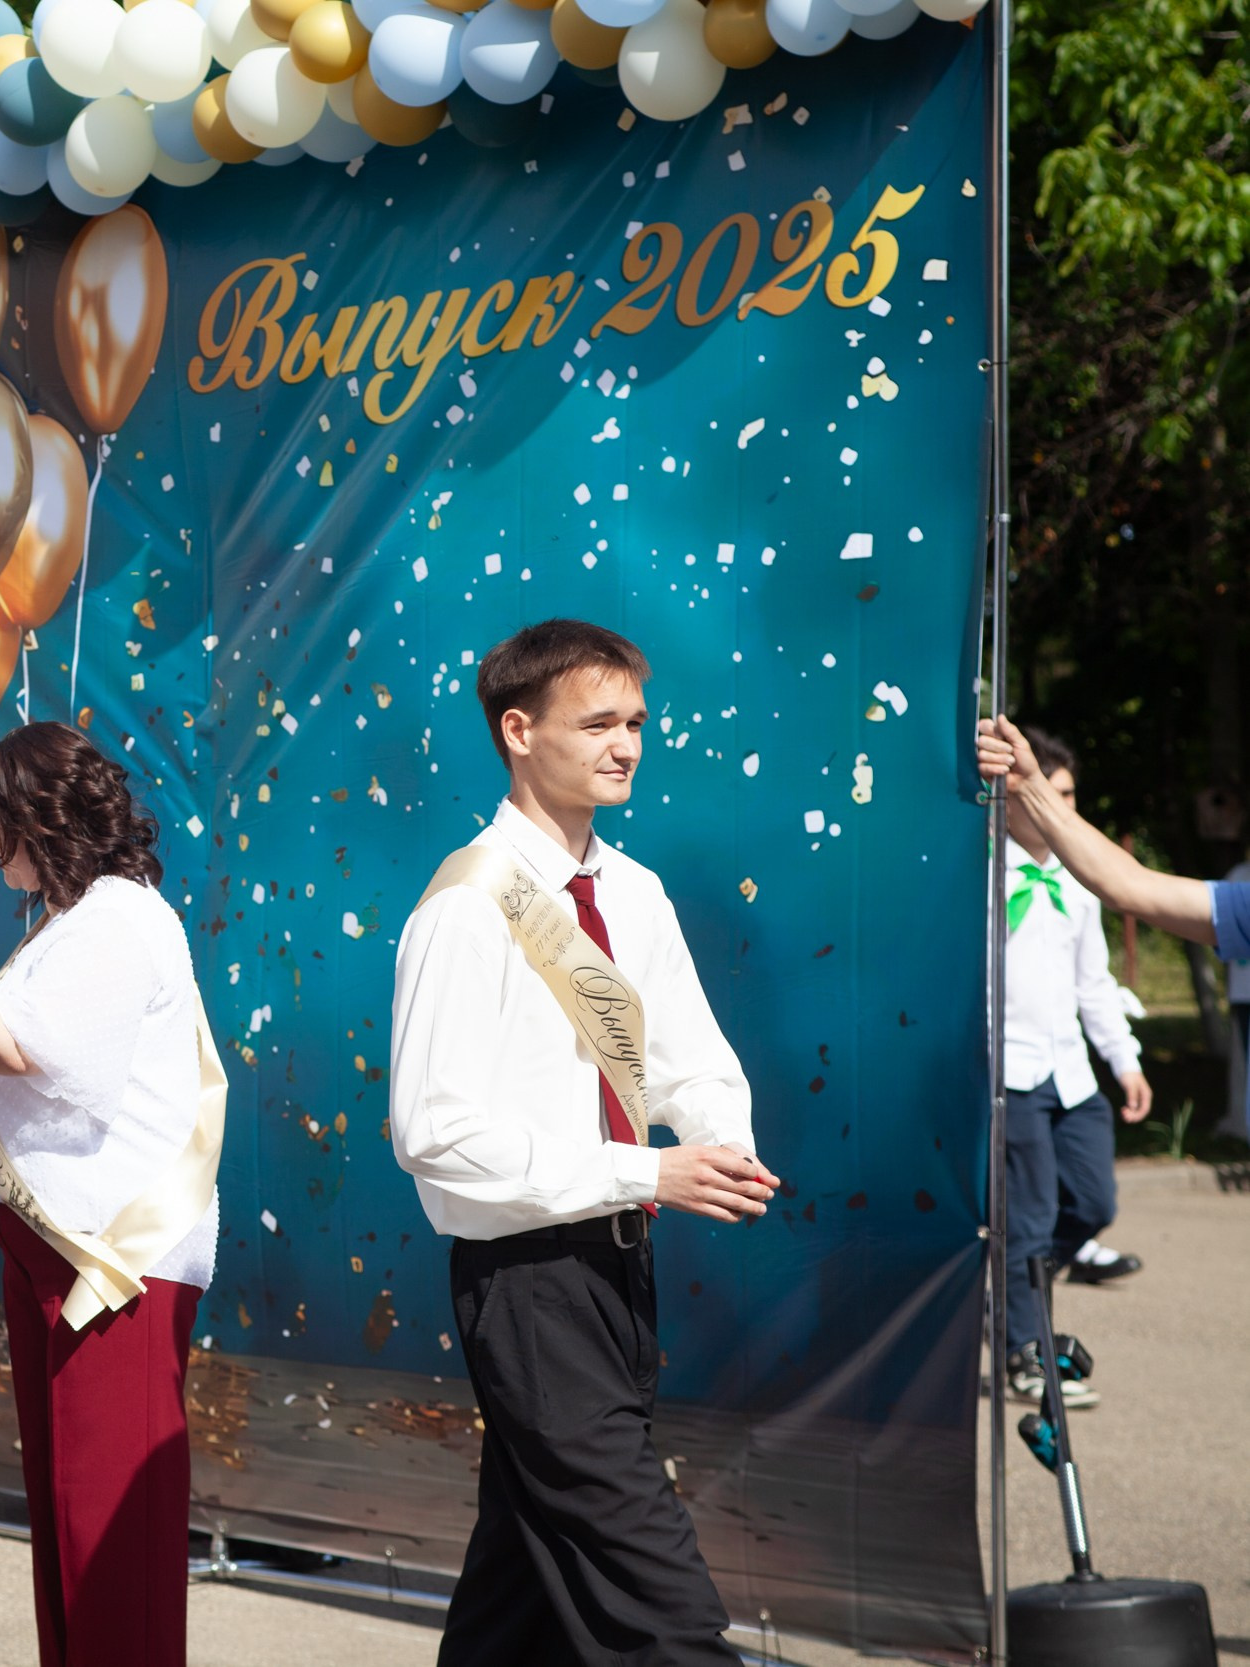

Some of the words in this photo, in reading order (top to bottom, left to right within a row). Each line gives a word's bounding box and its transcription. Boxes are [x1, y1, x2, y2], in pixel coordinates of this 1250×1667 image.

[188, 253, 584, 424] Выпуск
[591, 184, 925, 339] 2025
[570, 966, 648, 1117] Выпускн
